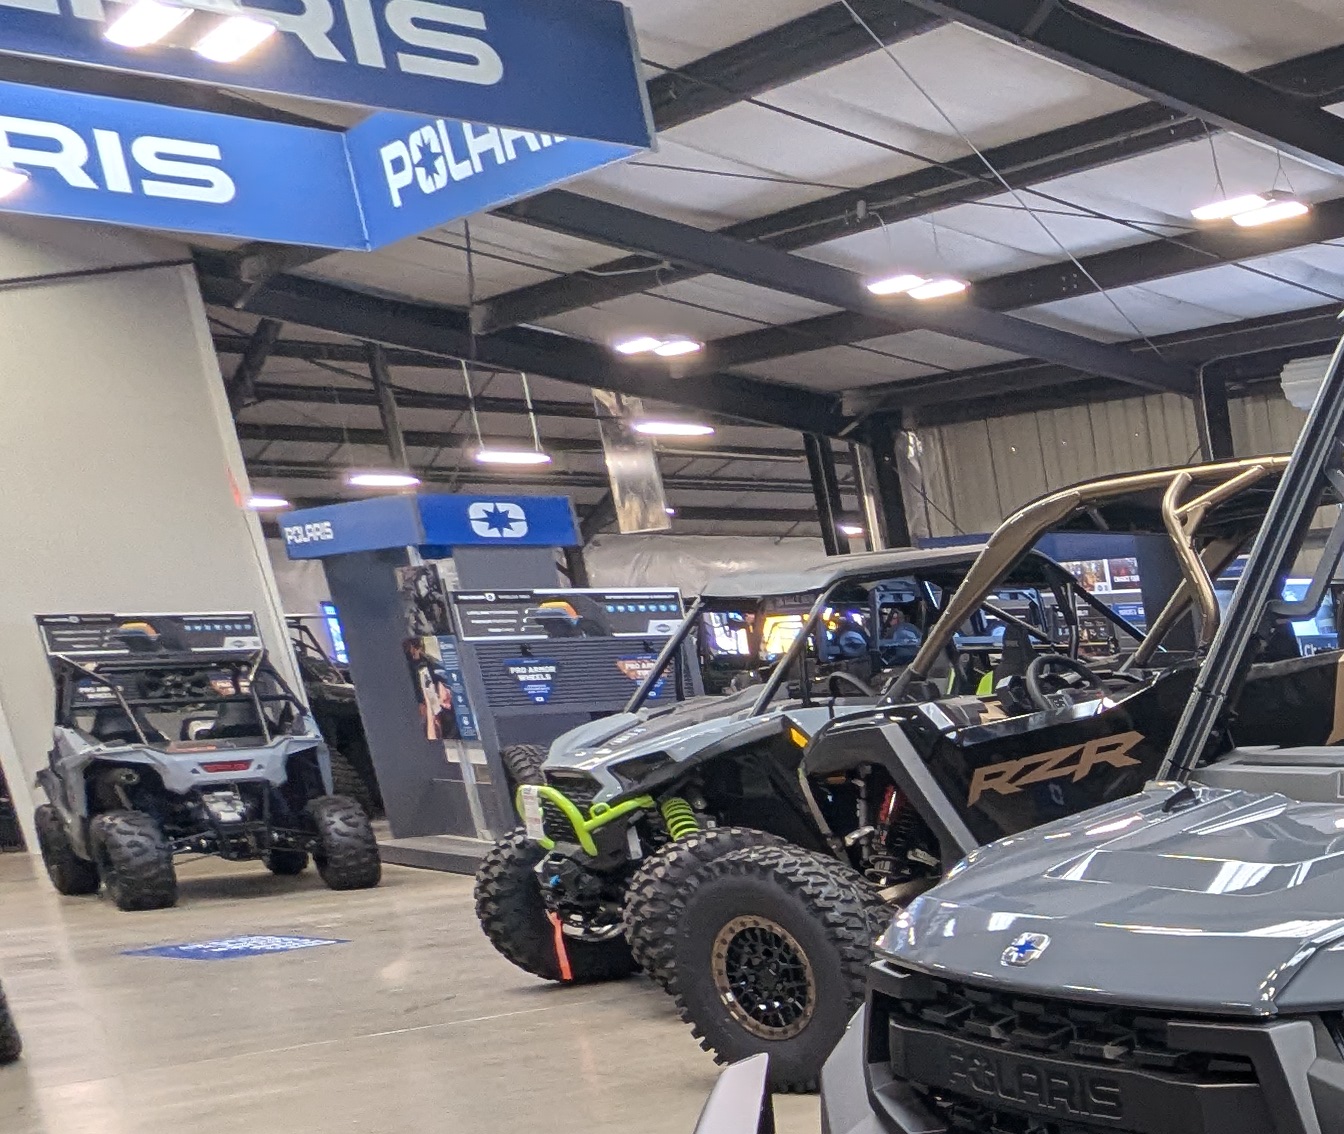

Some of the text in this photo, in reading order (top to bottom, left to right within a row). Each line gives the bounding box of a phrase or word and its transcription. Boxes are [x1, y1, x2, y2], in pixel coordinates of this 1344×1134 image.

[381, 119, 568, 207] POLA
[284, 521, 334, 545] POLARIS
[966, 730, 1146, 809] RZR
[948, 1046, 1124, 1120] POLARIS
